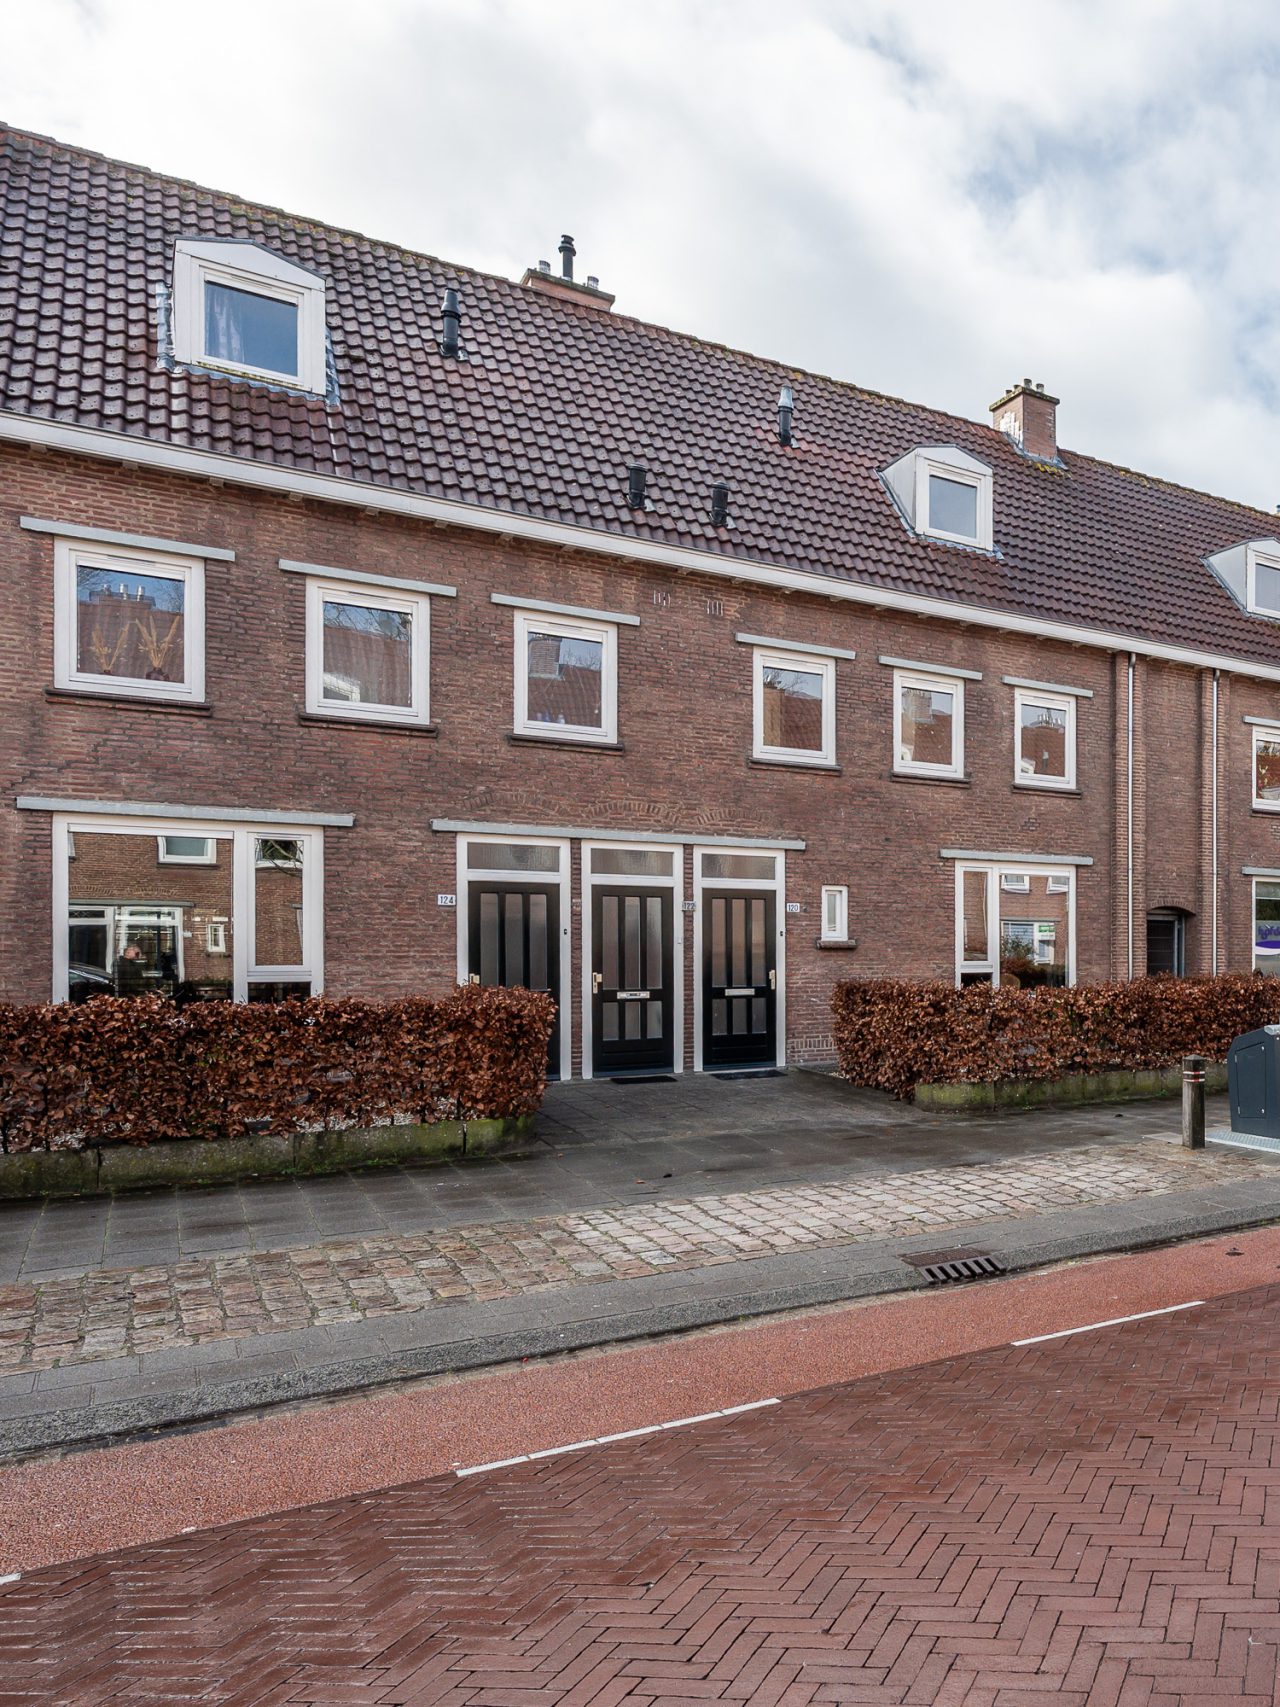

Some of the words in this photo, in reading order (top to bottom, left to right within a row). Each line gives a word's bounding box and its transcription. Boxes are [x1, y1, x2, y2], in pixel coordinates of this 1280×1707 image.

[440, 895, 454, 904] 124
[683, 902, 696, 910] 122
[788, 904, 799, 912] 120
